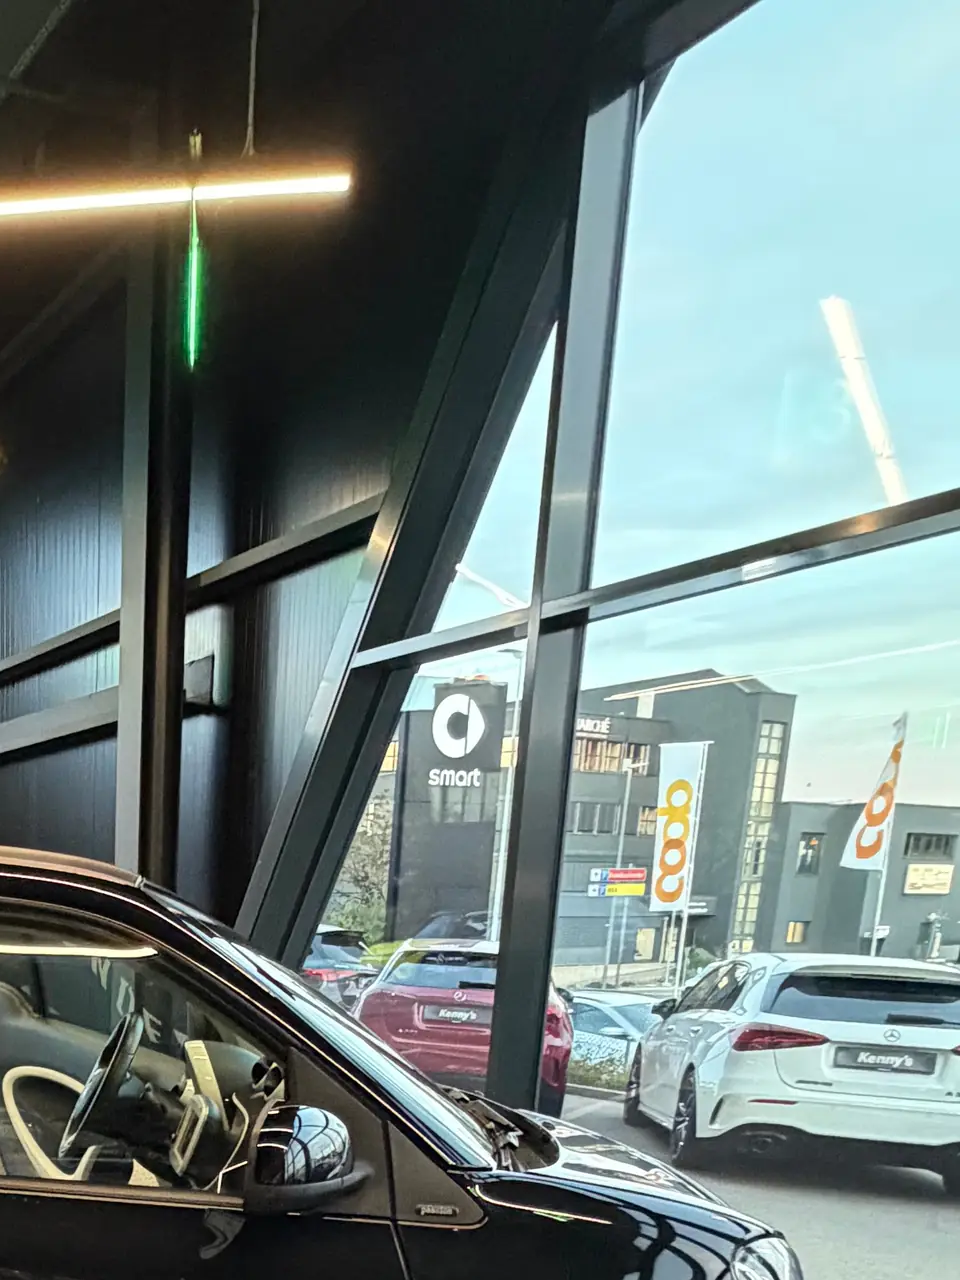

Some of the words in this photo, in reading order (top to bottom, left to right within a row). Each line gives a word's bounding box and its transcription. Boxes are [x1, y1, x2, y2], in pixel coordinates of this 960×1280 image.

[428, 768, 481, 787] smart
[655, 779, 694, 903] coop
[438, 1008, 477, 1021] Kenny's
[857, 1051, 914, 1068] Kenny's
